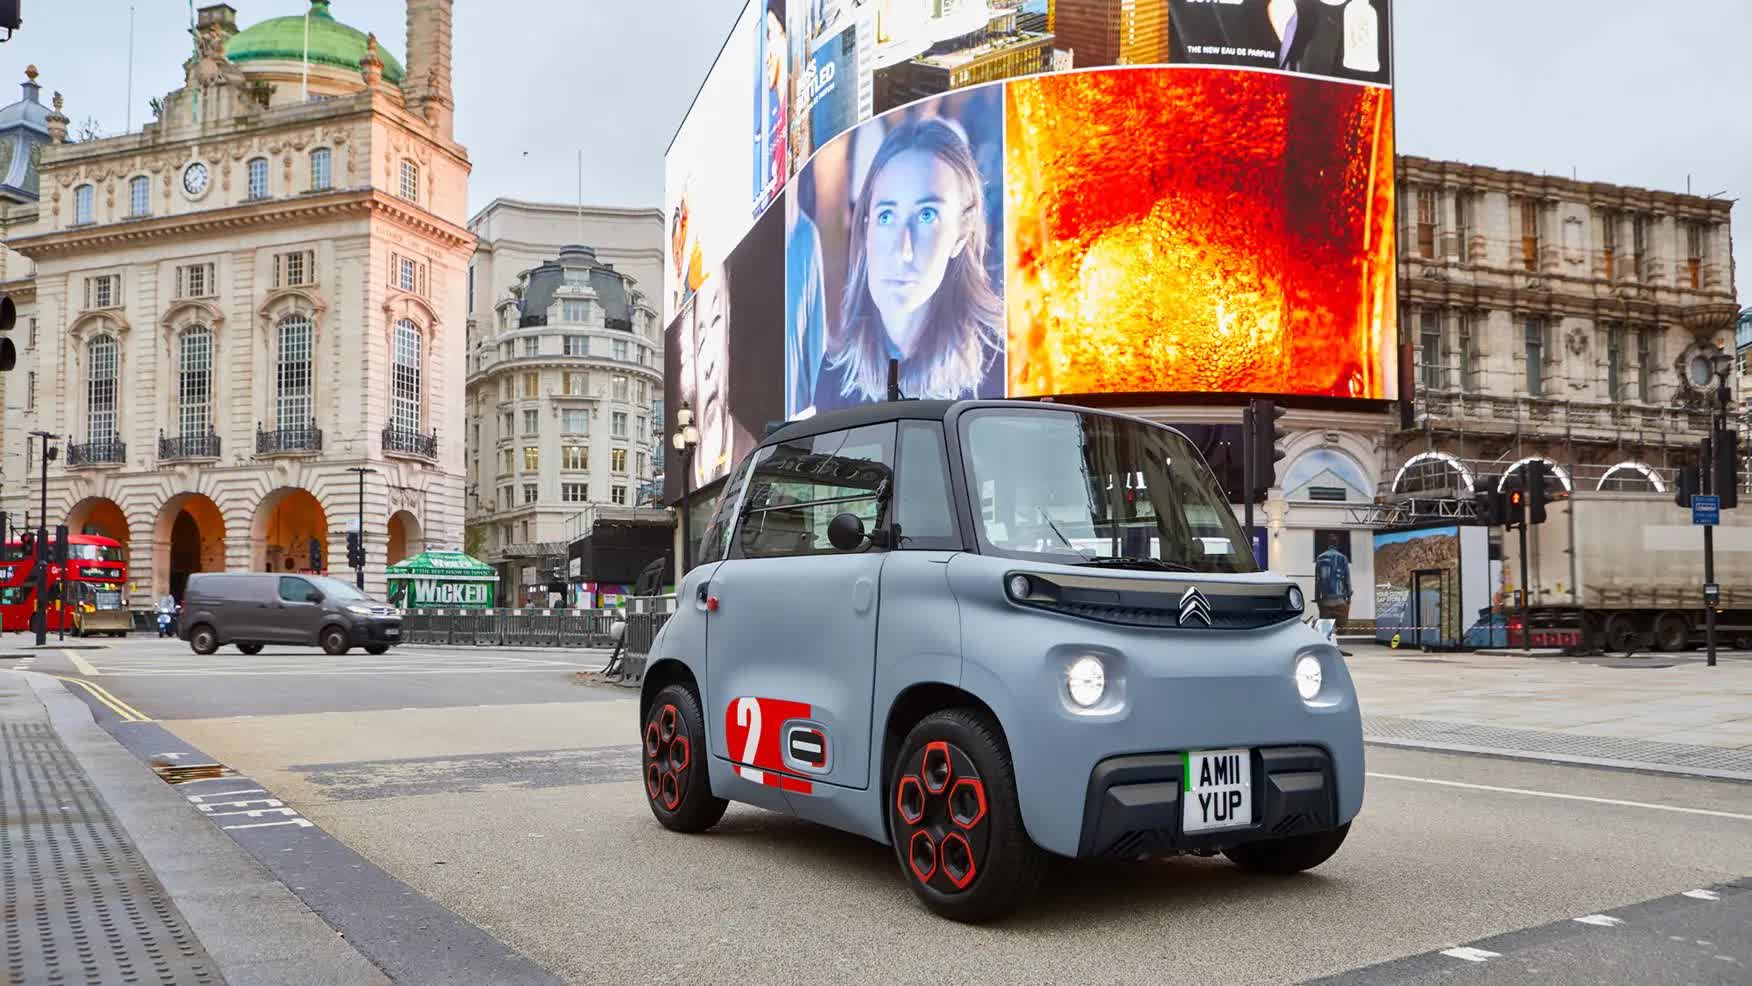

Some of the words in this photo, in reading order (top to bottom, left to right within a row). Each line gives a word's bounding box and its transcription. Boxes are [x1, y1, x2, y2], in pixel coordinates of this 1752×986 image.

[1187, 45, 1202, 54] THE
[1203, 46, 1220, 55] NEW
[1221, 46, 1235, 56] EAU
[1237, 48, 1246, 57] DE
[1247, 48, 1275, 59] PARFUM
[737, 696, 764, 785] 2
[187, 789, 314, 830] LEFT
[1198, 790, 1242, 823] YUP
